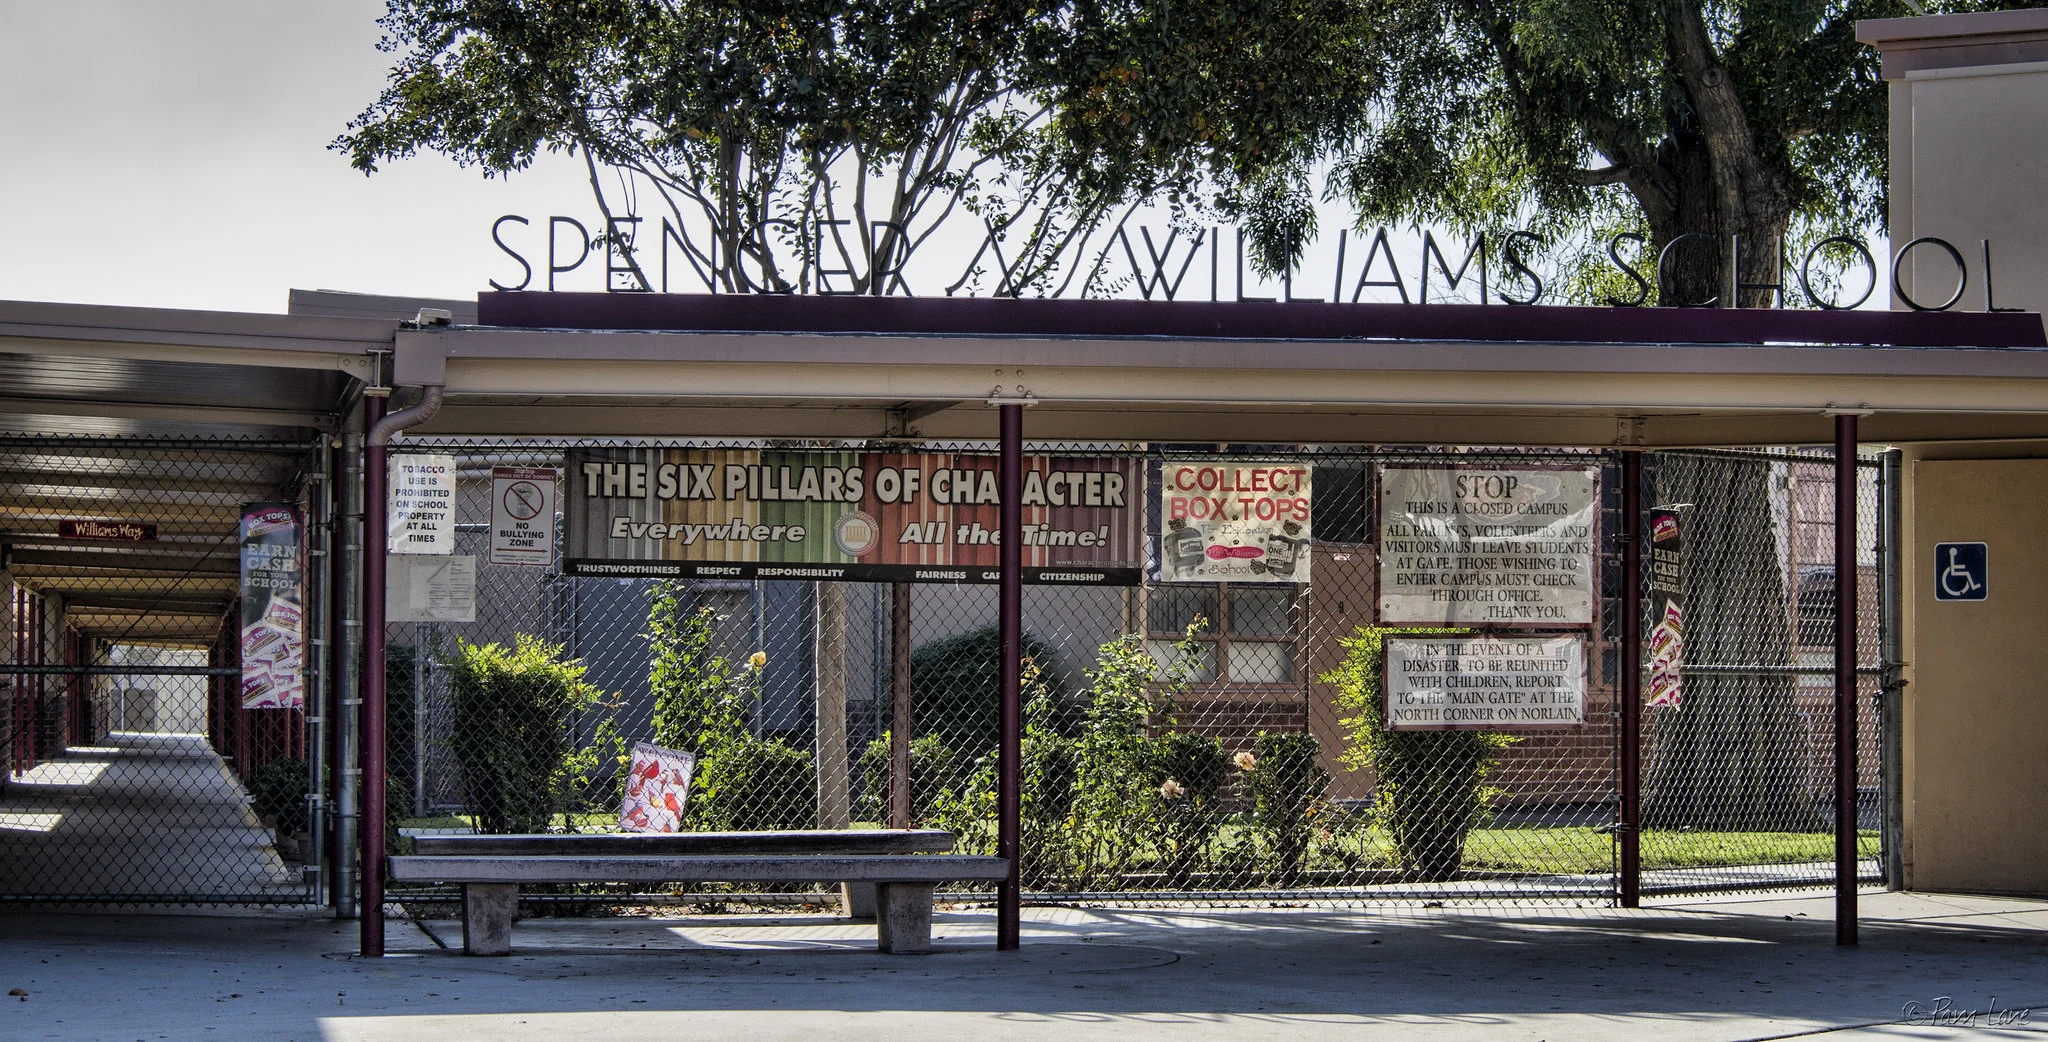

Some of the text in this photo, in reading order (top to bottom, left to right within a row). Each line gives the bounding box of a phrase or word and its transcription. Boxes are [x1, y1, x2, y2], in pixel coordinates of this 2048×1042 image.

[489, 214, 913, 297] SPENCER
[1117, 224, 1543, 306] WILLIAMS
[1605, 231, 2026, 313] SCHOOL
[402, 465, 445, 474] TOBACCO
[583, 462, 1125, 507] THE SIX PILLARS OF CHAACTER
[1175, 467, 1306, 492] COLLECT
[395, 489, 449, 497] PROHIBITED
[1456, 474, 1519, 499] STOP
[412, 501, 448, 509] SCHOOL
[1170, 496, 1309, 521] BOX TOPS
[1405, 501, 1568, 515] THIS IS A CLOSED CAMPUS
[248, 512, 289, 529] BOX TOPS
[398, 512, 445, 520] PROPERTY
[75, 522, 143, 540] Williams Way
[406, 522, 418, 530] AT
[516, 522, 529, 530] NO
[610, 516, 806, 545] Everywhere
[1387, 524, 1588, 539] ALL PARENTS, VOLUNTEERS AND
[408, 535, 435, 543] TIMES
[500, 531, 544, 539] BULLYING
[899, 521, 947, 545] All
[1022, 523, 1109, 547] Time!
[509, 539, 534, 547] ZONE
[1385, 541, 1589, 554] VISITORS MUST LEAVE STUDENTS
[247, 543, 297, 557] EARN
[1225, 548, 1261, 557] Williams
[1268, 546, 1283, 555] ONE
[1654, 548, 1680, 564] EARN
[246, 557, 295, 572] CASH
[1208, 564, 1250, 574] School
[1396, 557, 1577, 570] AT GATE. THOSE WISHING TO
[1654, 562, 1678, 577] CASH
[577, 564, 680, 574] TRUSTWORTHINESS
[696, 566, 741, 575] RESPECT
[757, 567, 845, 577] RESPONSIBILITY
[915, 570, 966, 580] FAIRNESS
[1039, 572, 1105, 581] CITIZENSHIP
[244, 578, 297, 589] SCHOOL
[1396, 573, 1437, 586] ENTER
[1441, 573, 1492, 586] CAMPUS
[1533, 573, 1577, 586] CHECK
[1653, 580, 1681, 593] SCHOOL
[1431, 589, 1543, 602] THROUGH OFFICE.
[1487, 606, 1566, 618] THANK YOU.
[1426, 643, 1545, 656] IN THE EVENT OF A
[1403, 659, 1568, 673] DISASTER, TO BE REUNITED
[1409, 675, 1563, 690] WITH CHILDREN, REPORT
[1397, 691, 1575, 704] TO THE "MAIN GATE" AT THE
[1395, 708, 1439, 721] NORTH
[1443, 708, 1494, 721] CORNER
[1498, 708, 1517, 720] ON
